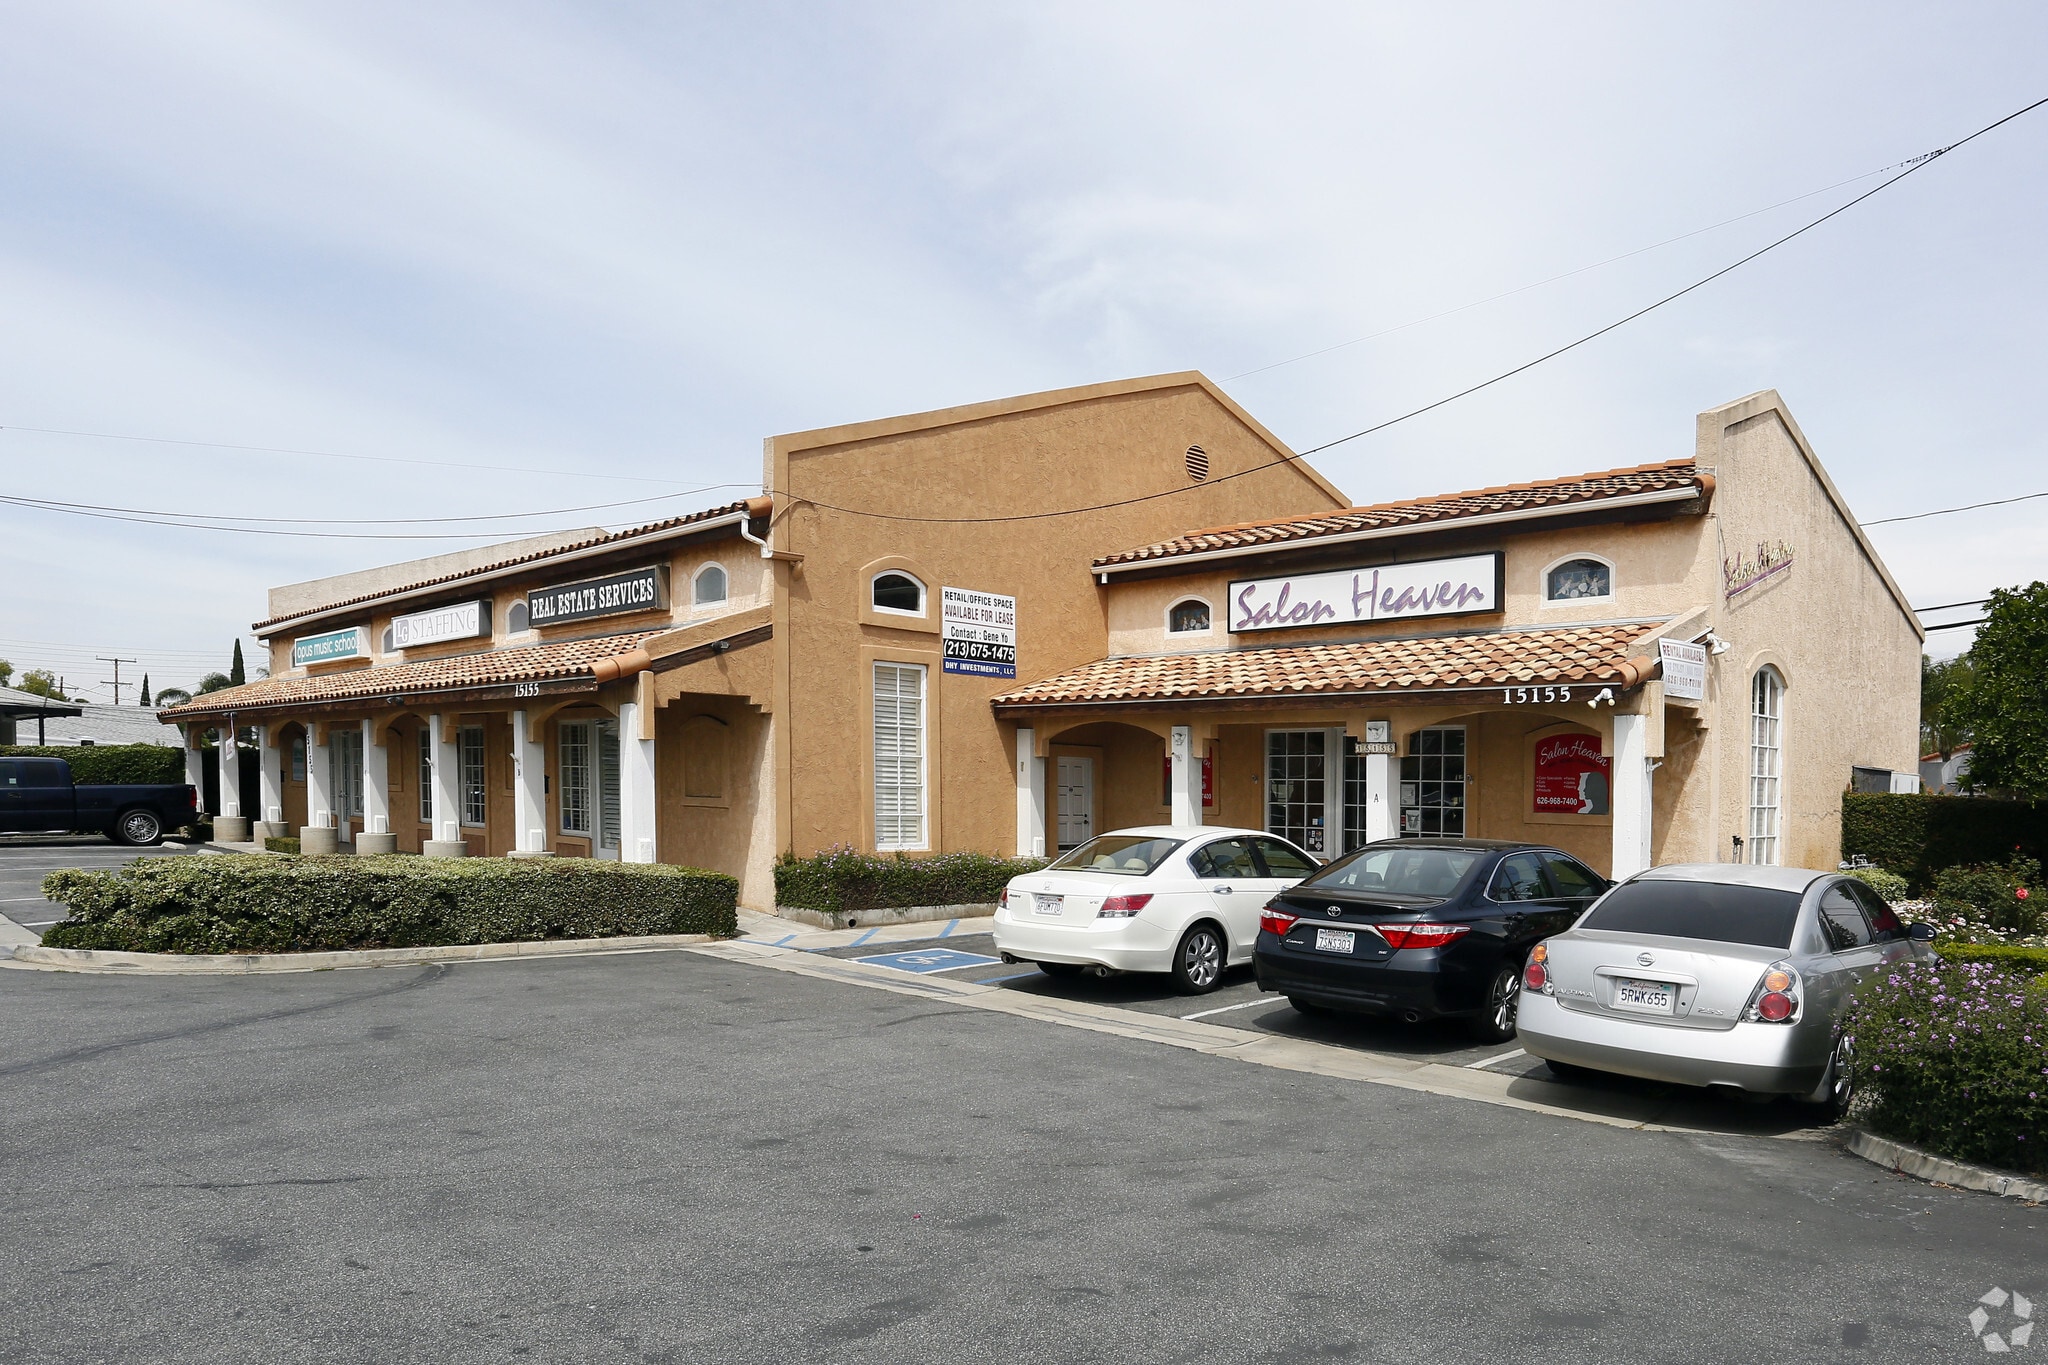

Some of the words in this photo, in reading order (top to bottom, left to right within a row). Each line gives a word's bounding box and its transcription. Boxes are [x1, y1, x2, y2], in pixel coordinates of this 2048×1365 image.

[531, 595, 555, 619] REAL
[557, 588, 596, 615] ESTATE
[598, 577, 653, 609] SERVICES
[944, 591, 991, 607] RETAIL/OFFICE
[993, 598, 1013, 609] SPACE
[1236, 581, 1336, 629] Salon
[1351, 569, 1485, 619] Heaven
[944, 604, 978, 620] AVAILABLE
[981, 609, 993, 622] FOR
[995, 611, 1013, 625] LEASE
[397, 622, 408, 642] LG
[412, 608, 476, 639] STAFFING
[950, 626, 977, 639] Contact
[983, 630, 999, 642] Gene
[297, 644, 313, 662] opus
[313, 638, 333, 655] music
[334, 632, 357, 652] school
[943, 639, 969, 658] (213)
[970, 643, 1014, 661] 675-1475
[945, 661, 958, 669] DHY
[514, 683, 539, 697] 15155
[1503, 686, 1571, 704] 15155
[1356, 744, 1394, 752] 15155
[1540, 741, 1569, 765] Salon
[1569, 740, 1608, 766] Heaven
[1373, 793, 1379, 803] A
[1557, 987, 1594, 998] ALTIMA
[1630, 981, 1662, 990] California
[1621, 988, 1667, 1006] 5RWK655
